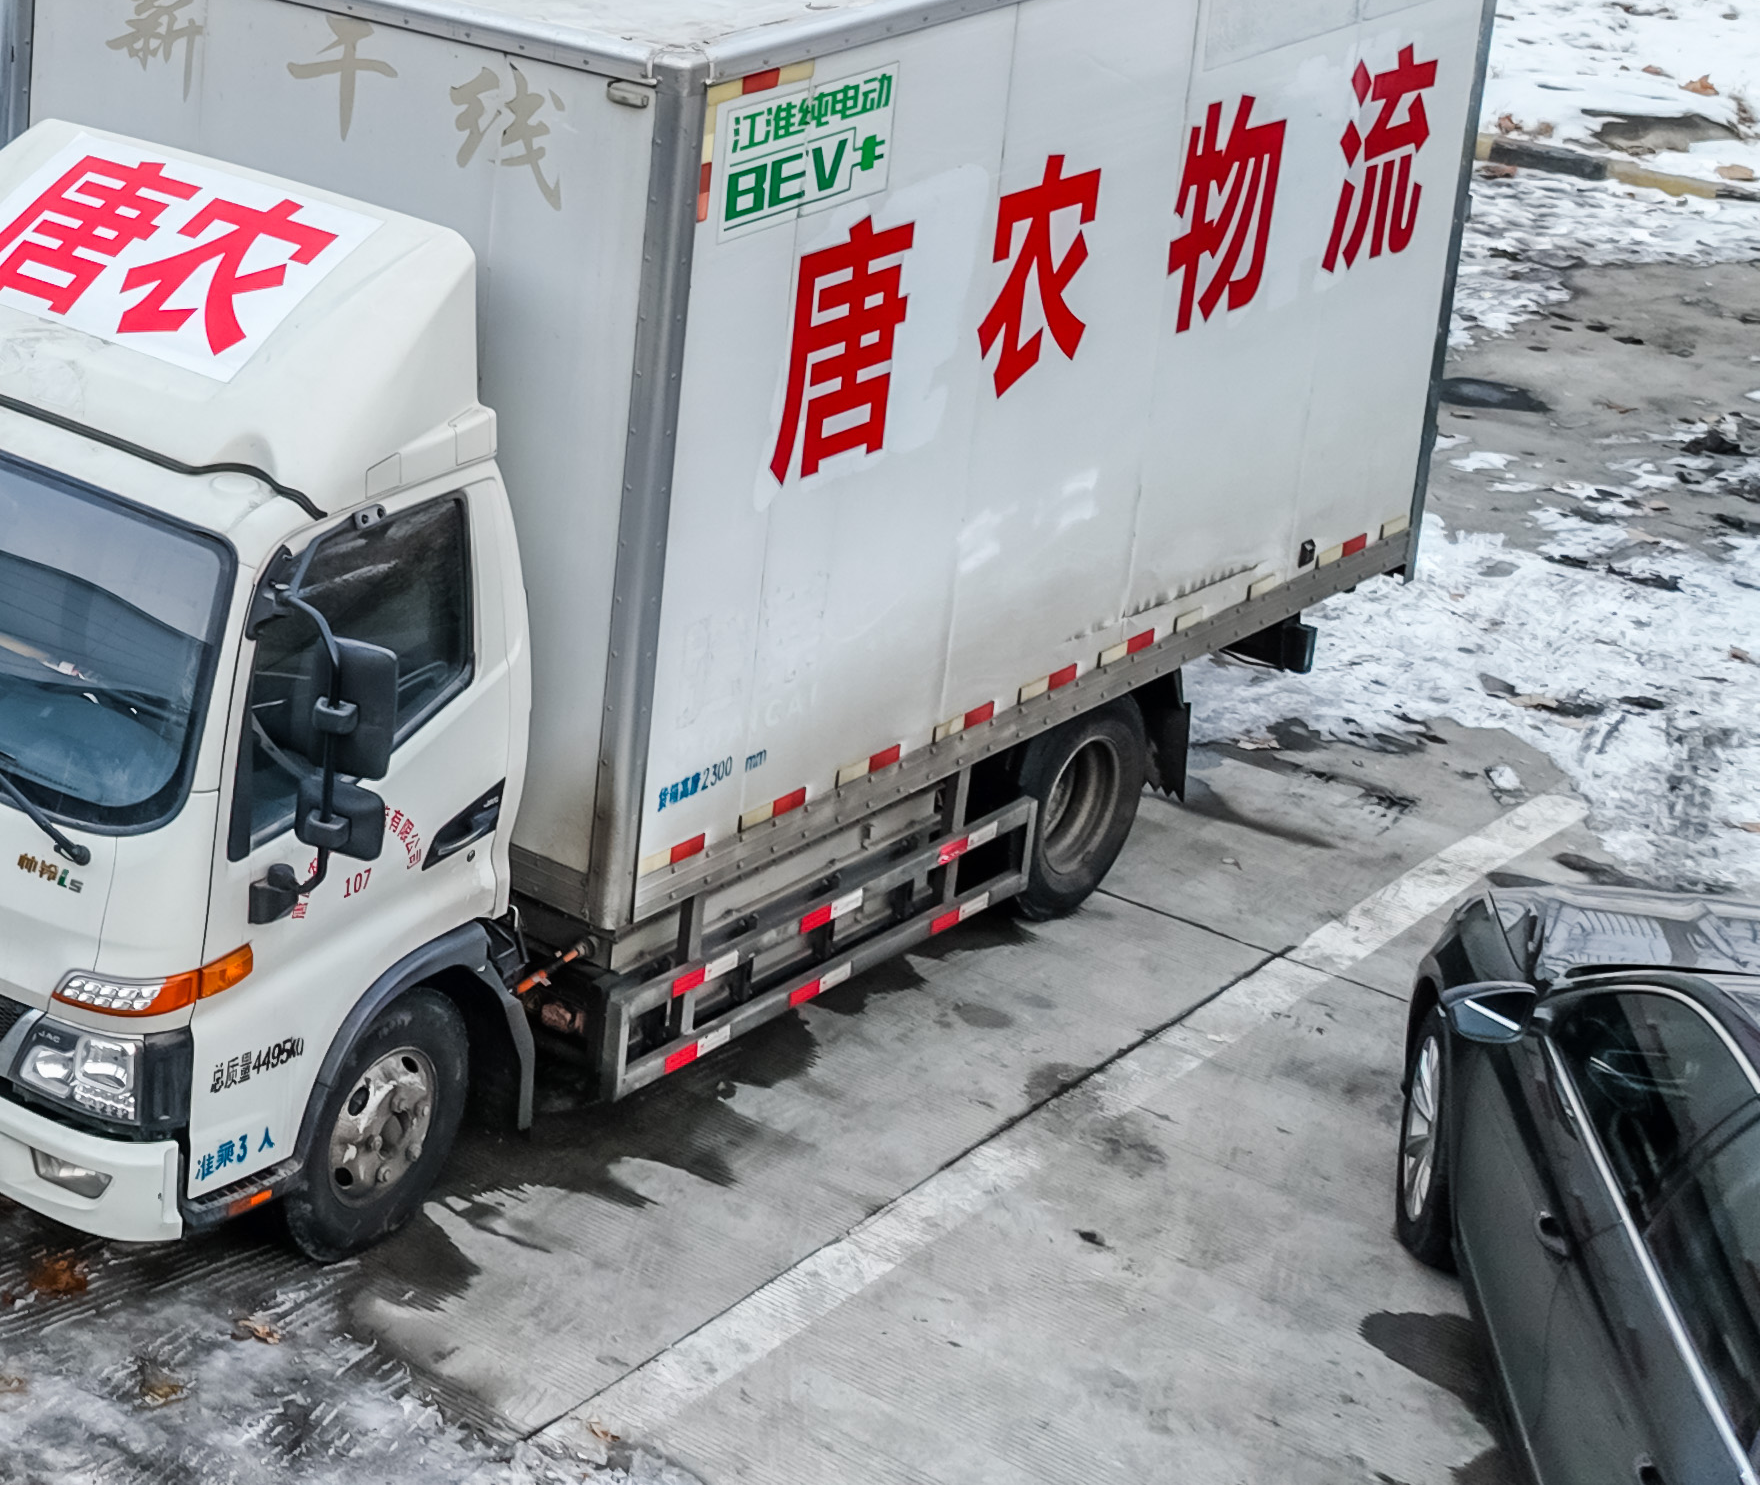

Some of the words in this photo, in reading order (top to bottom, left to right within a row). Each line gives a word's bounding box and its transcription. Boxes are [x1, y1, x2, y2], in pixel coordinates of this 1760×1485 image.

[732, 73, 893, 154] 江淮纯电动
[725, 137, 849, 222] BEV
[770, 44, 1439, 486] 唐农物流
[343, 868, 372, 899] 107
